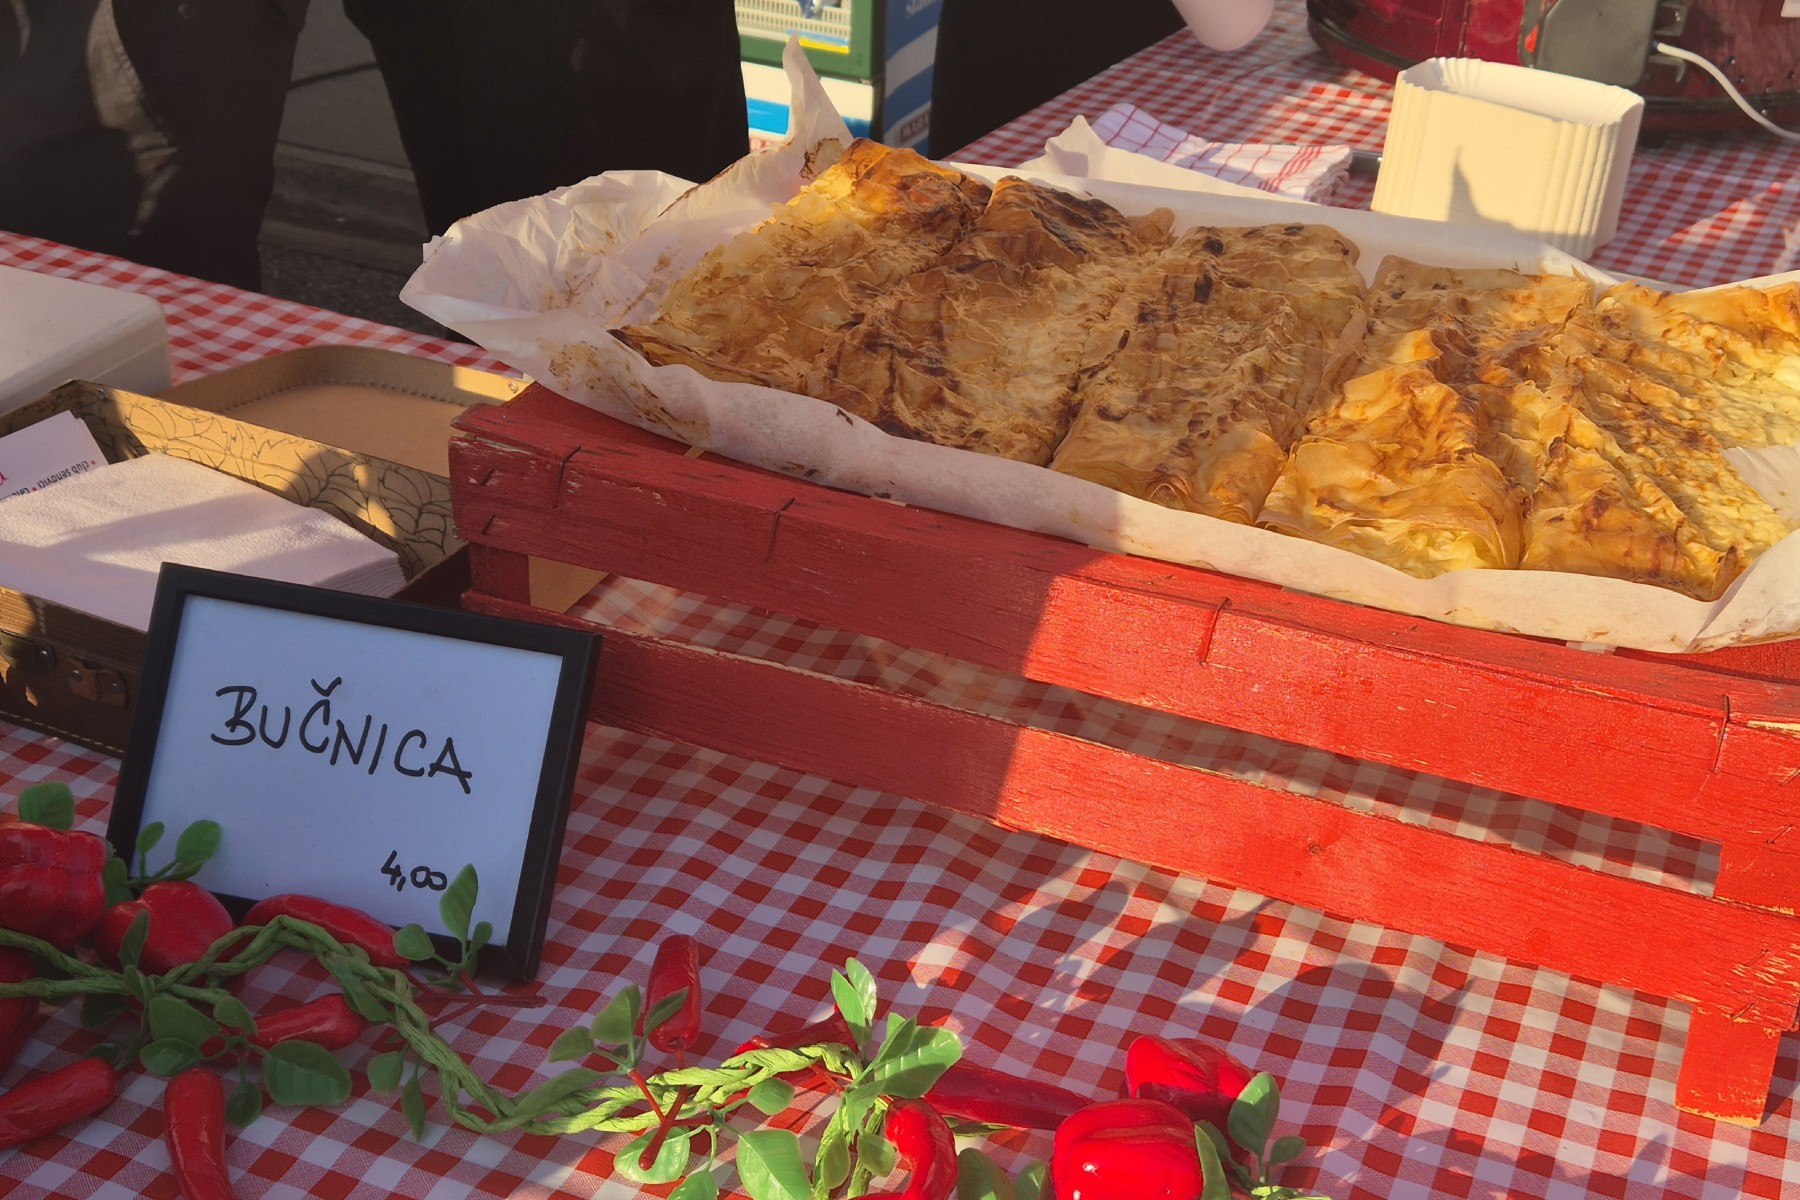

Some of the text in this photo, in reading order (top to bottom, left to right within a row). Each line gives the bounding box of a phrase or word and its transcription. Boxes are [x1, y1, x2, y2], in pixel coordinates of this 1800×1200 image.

[71, 460, 90, 474] club
[210, 676, 473, 795] BUČNICA
[380, 850, 448, 892] 4,00
